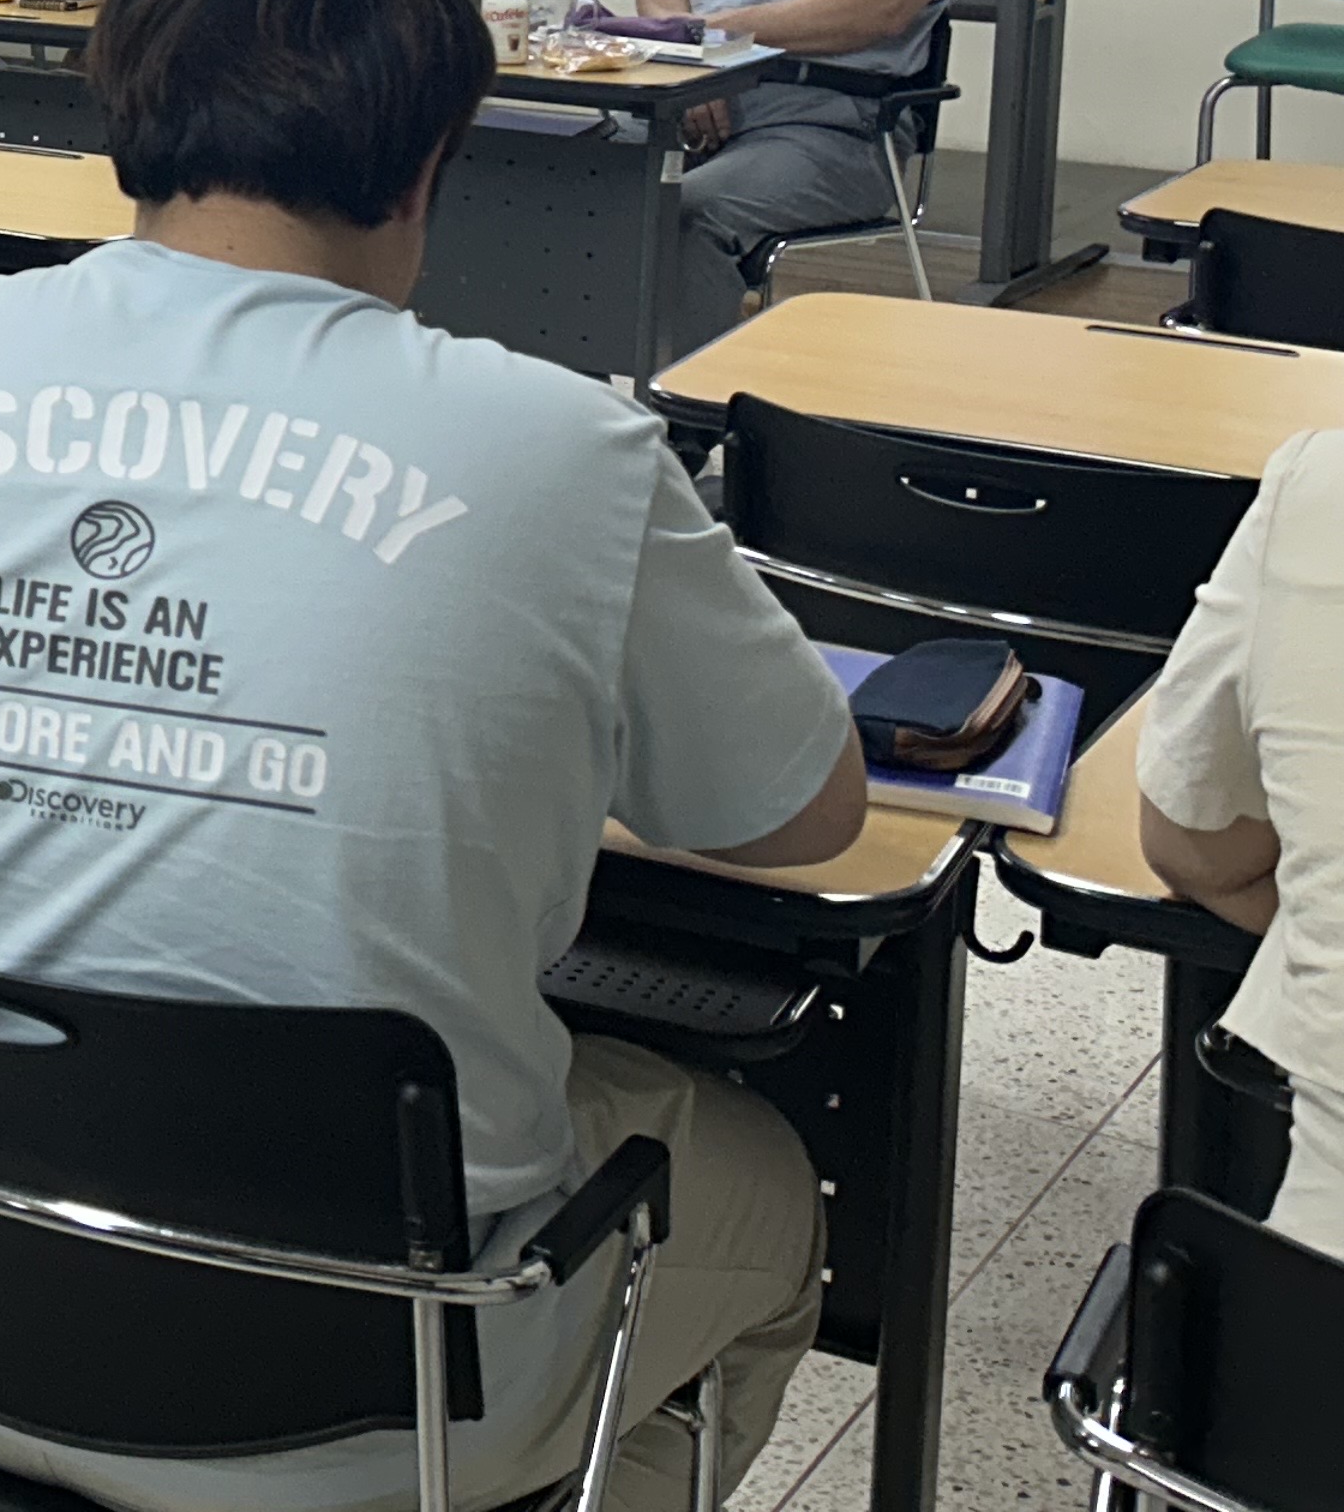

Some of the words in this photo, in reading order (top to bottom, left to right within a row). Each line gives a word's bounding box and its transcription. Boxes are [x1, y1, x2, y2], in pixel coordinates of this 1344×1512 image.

[85, 587, 129, 632] IS
[144, 598, 208, 641] AN
[108, 718, 225, 783] AND
[247, 737, 328, 797] GO
